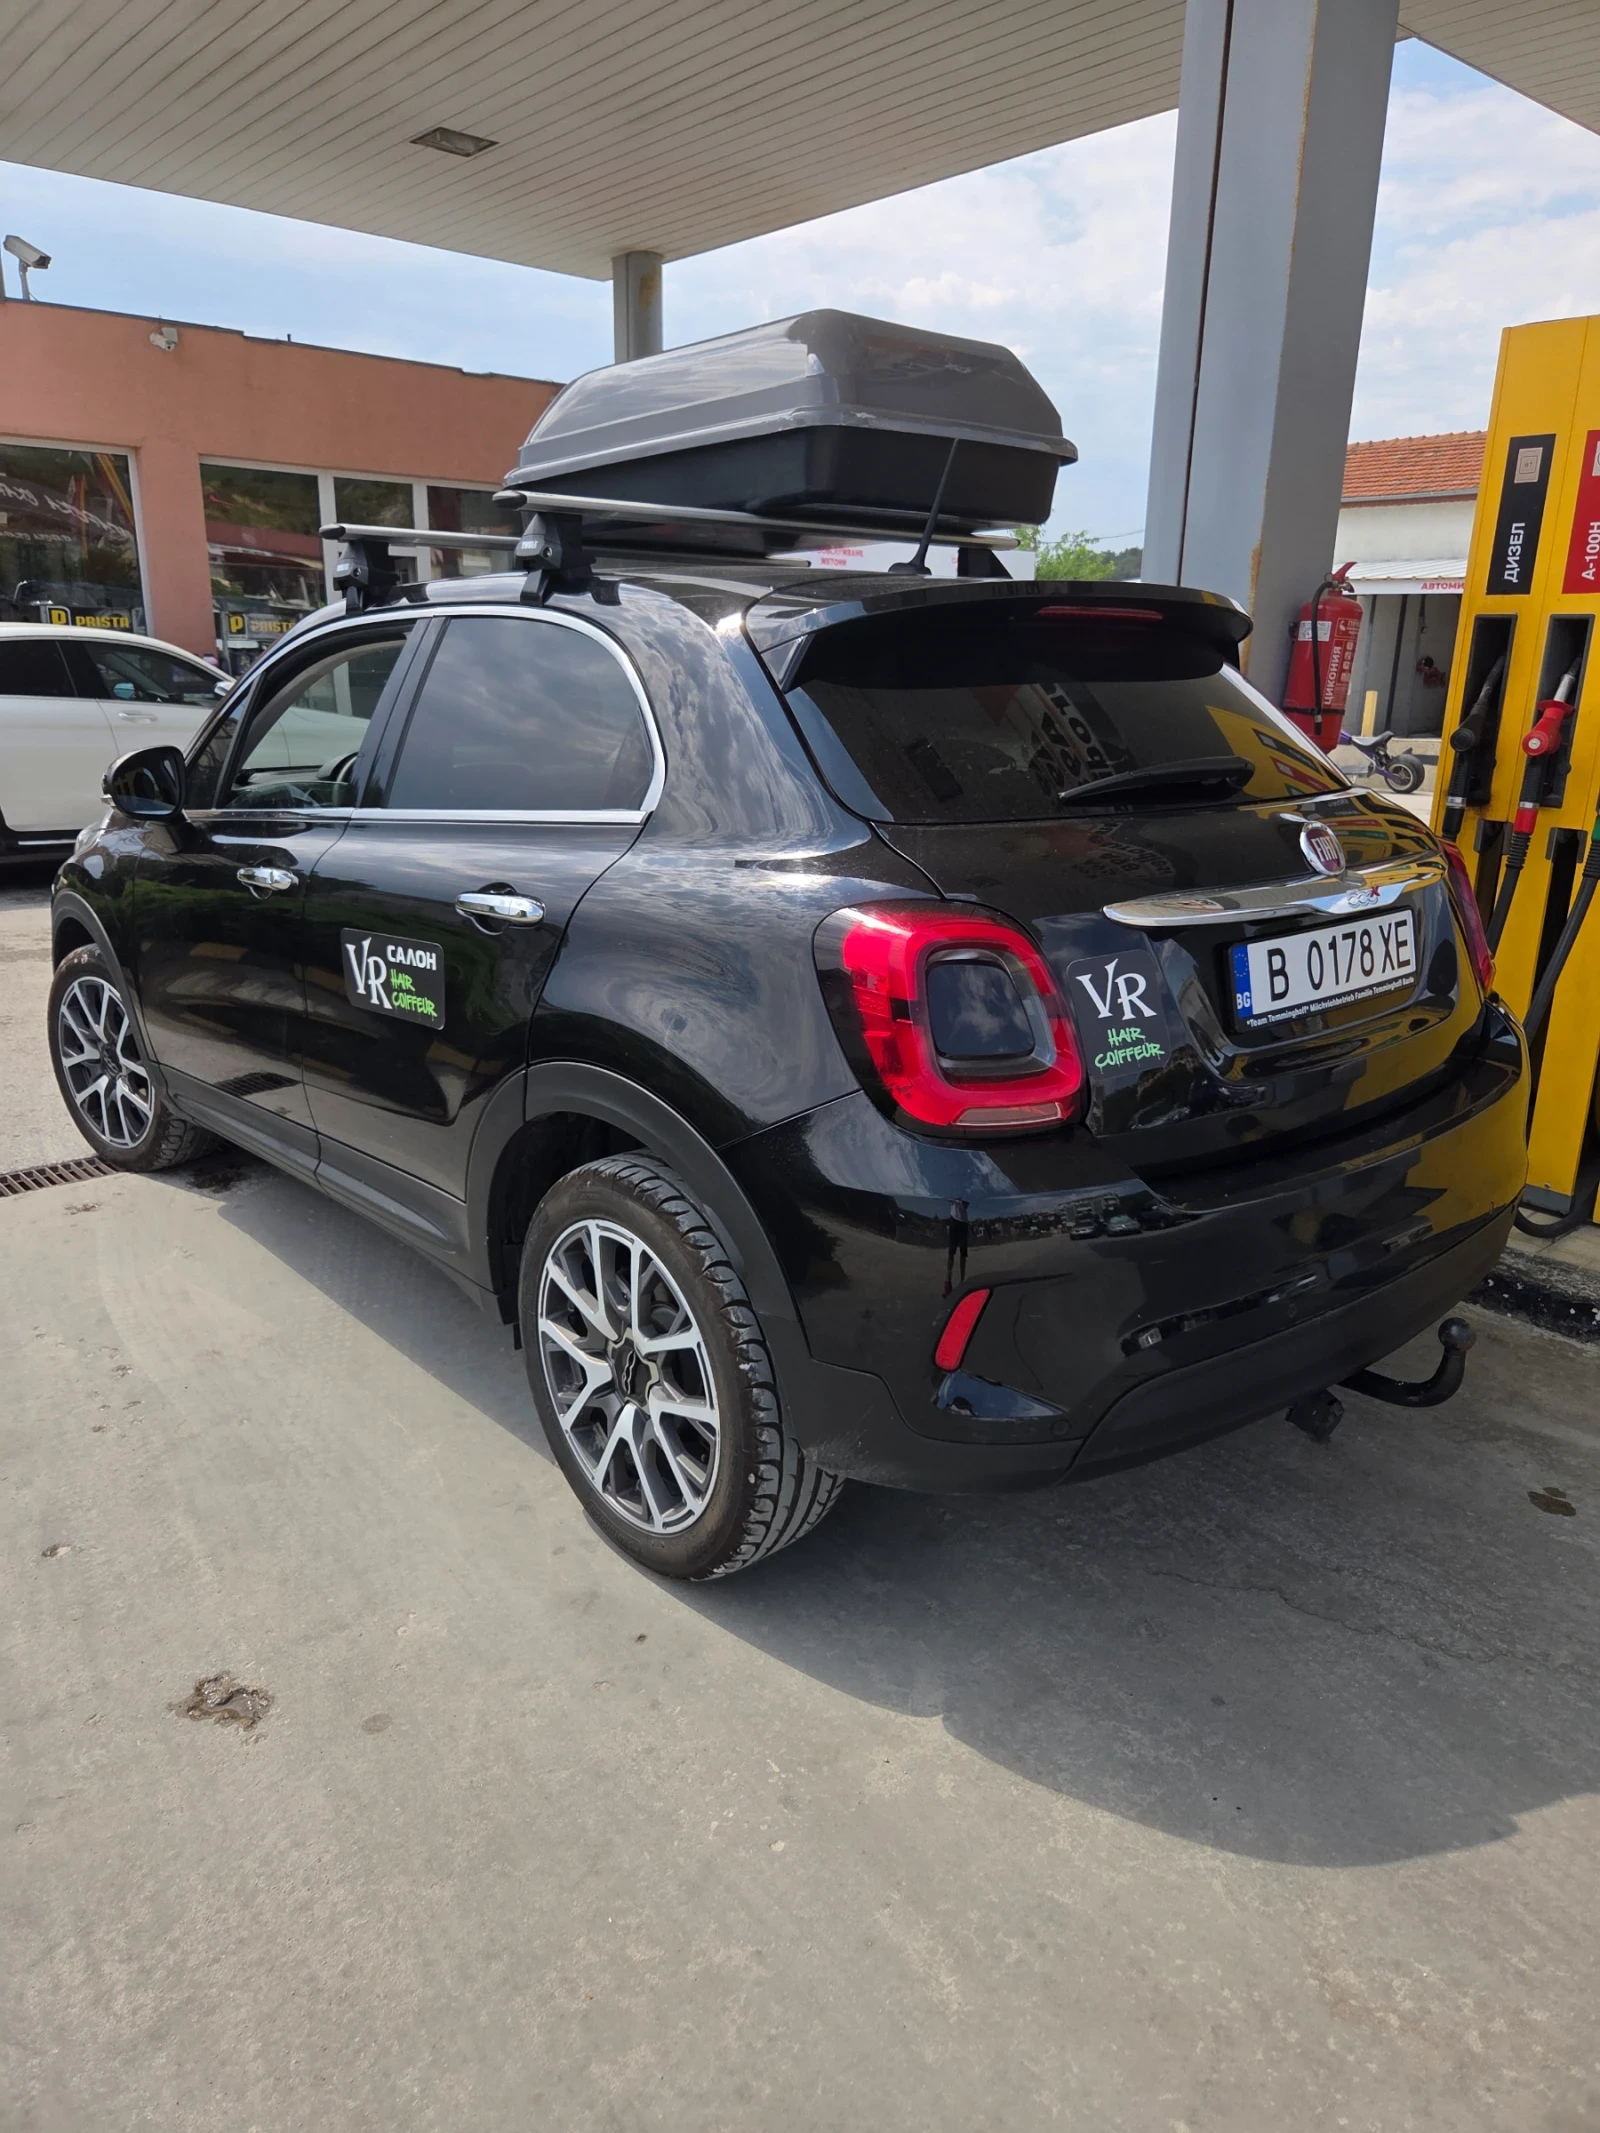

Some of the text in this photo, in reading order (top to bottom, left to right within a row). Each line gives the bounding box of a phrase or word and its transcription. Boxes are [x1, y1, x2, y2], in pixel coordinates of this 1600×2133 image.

[1504, 522, 1526, 583] ДИЗЕЛ
[75, 616, 130, 629] PRISTA
[1324, 646, 1342, 705] ЦИКОНИЯ
[1310, 836, 1338, 862] FIAT
[386, 944, 437, 971] САЛОН
[1267, 919, 1411, 1002] B 0178 XE
[345, 936, 393, 1010] VR
[390, 968, 416, 992] HAIR
[1075, 958, 1158, 1021] VR
[1236, 991, 1251, 1010] BG
[391, 991, 438, 1020] COIFFEUR
[1107, 1027, 1146, 1047] HAIR
[1094, 1043, 1166, 1070] COIFFEUR
